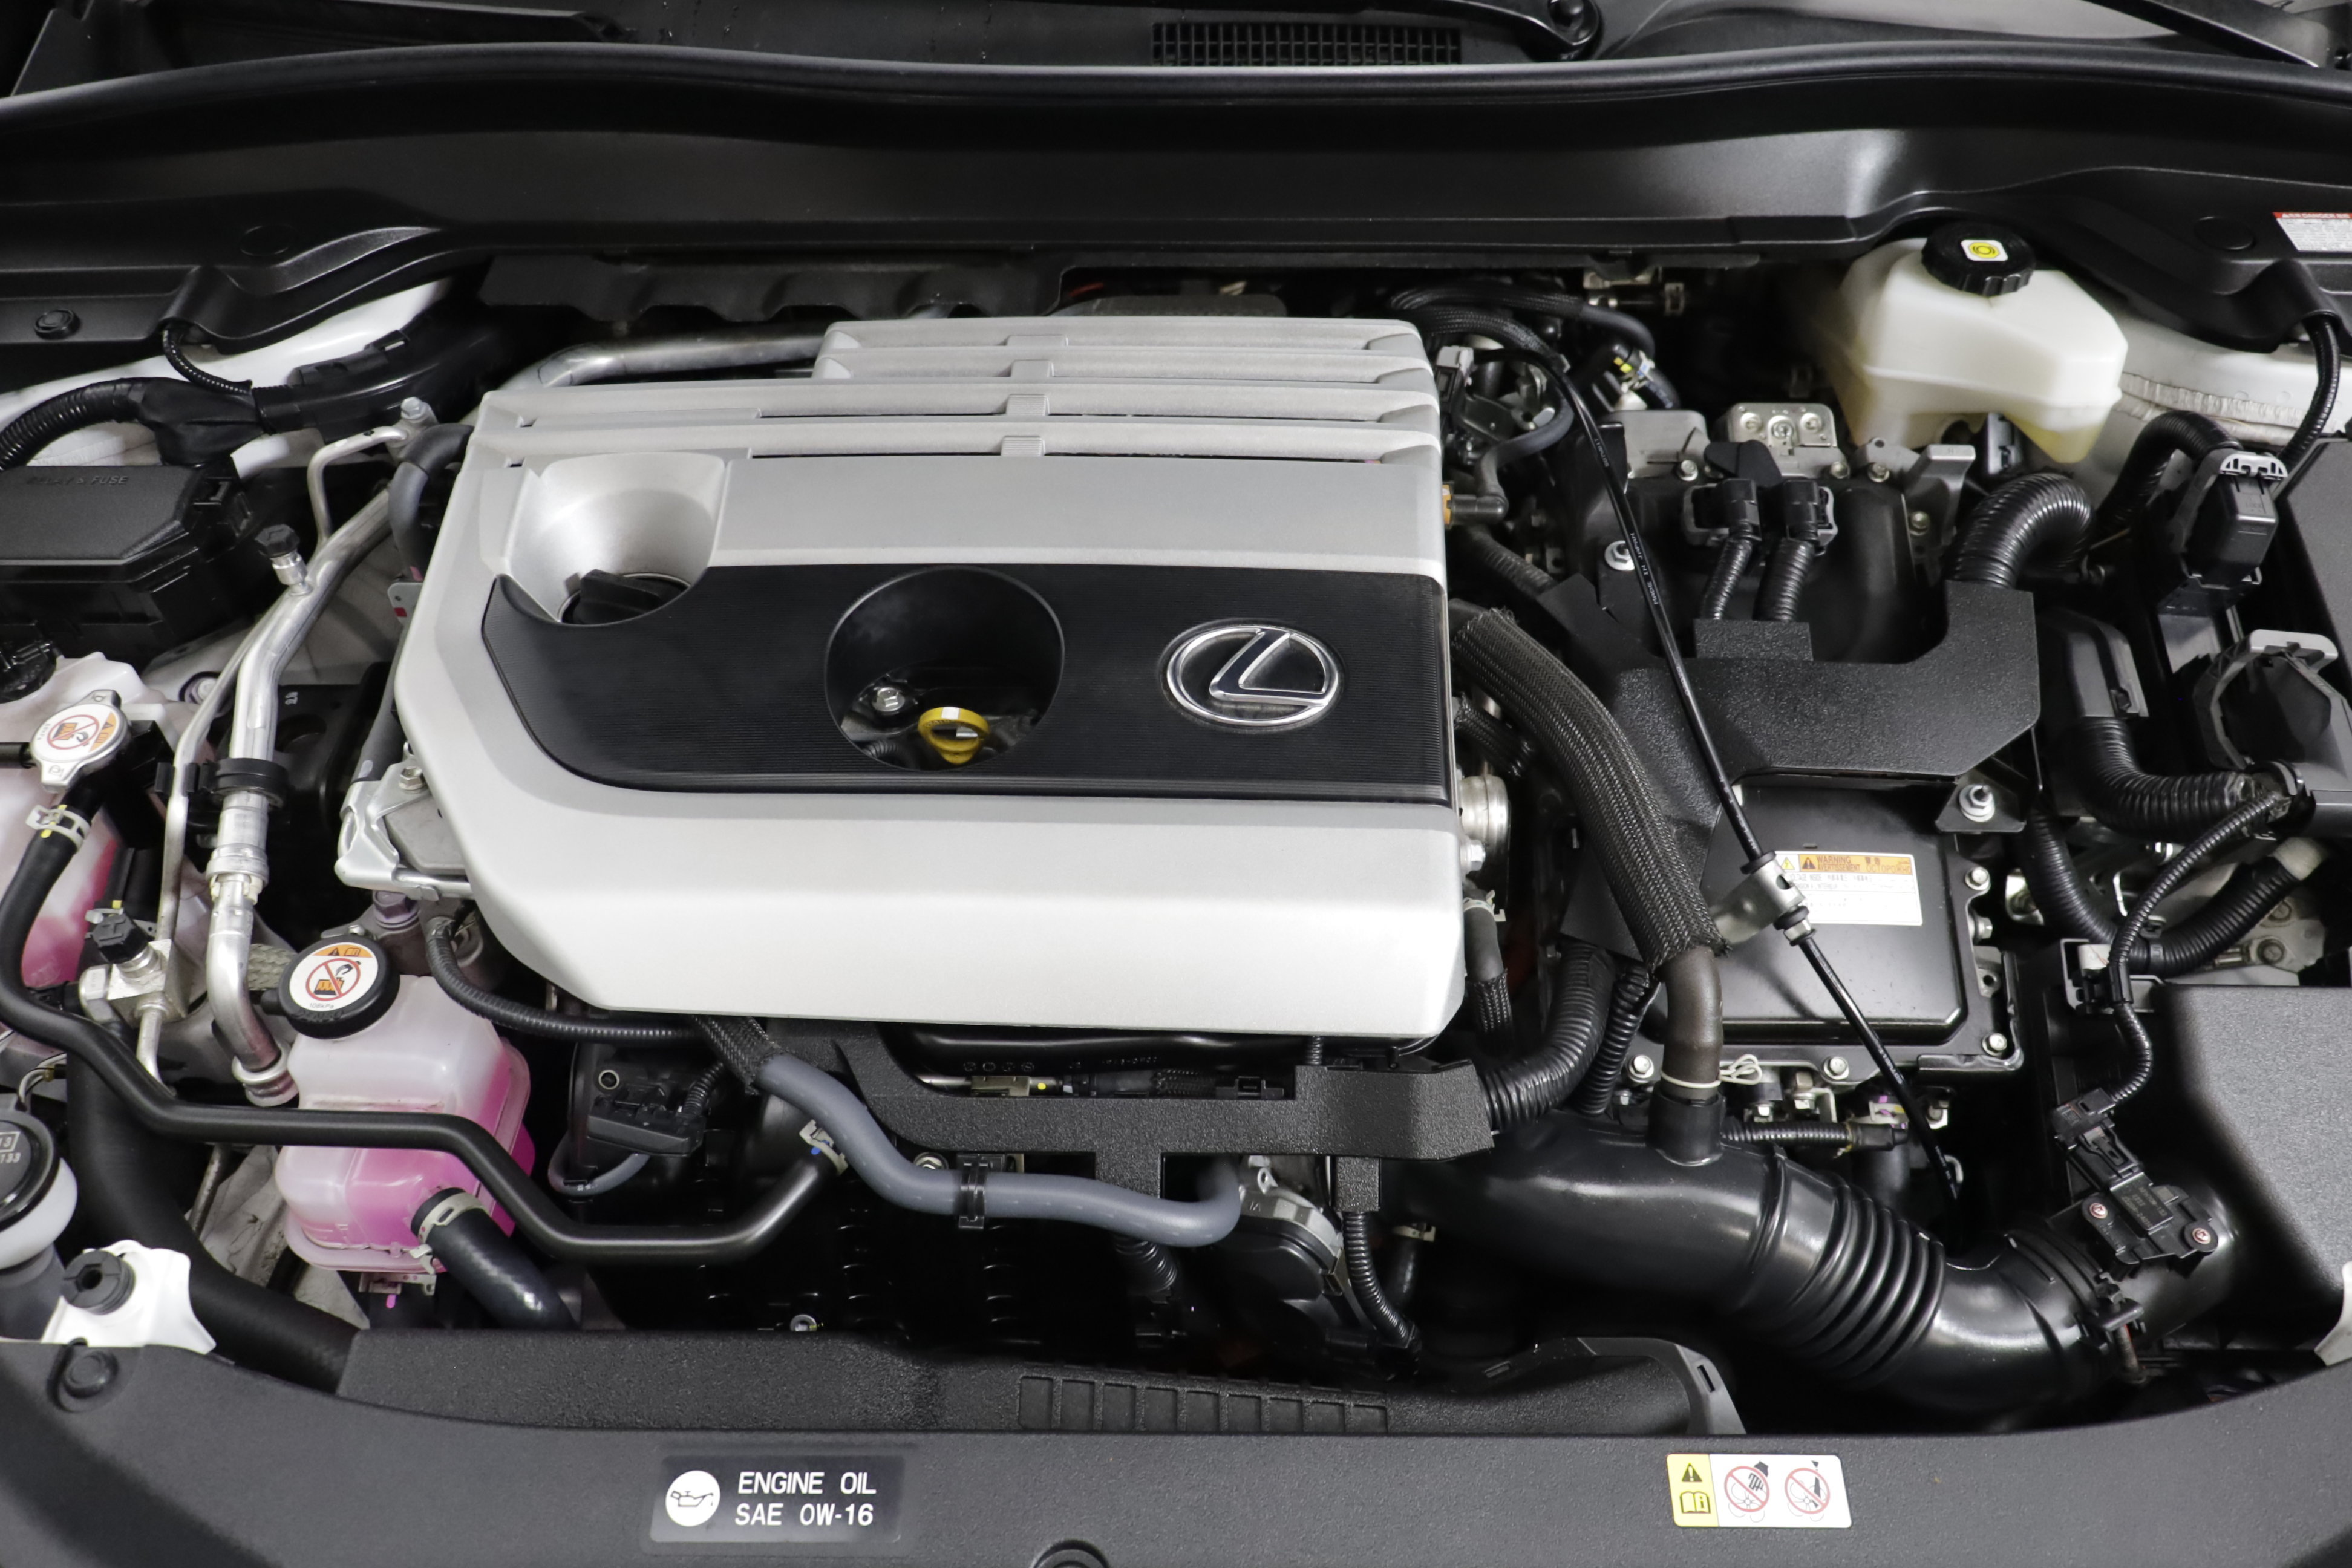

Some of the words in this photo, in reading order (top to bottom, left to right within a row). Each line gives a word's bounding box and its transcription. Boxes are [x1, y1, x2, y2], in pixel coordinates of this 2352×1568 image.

[91, 475, 128, 485] FUSE
[1629, 532, 1644, 560] JAPAN
[1641, 564, 1649, 576] IN
[1646, 580, 1659, 605] MADE
[1817, 855, 1851, 864] WARNING
[1818, 863, 1861, 872] AVERTISSEMENT
[737, 1471, 825, 1495] ENGINE
[840, 1471, 877, 1495] OIL
[734, 1503, 784, 1526] SAE
[799, 1503, 874, 1526] 0W-16
